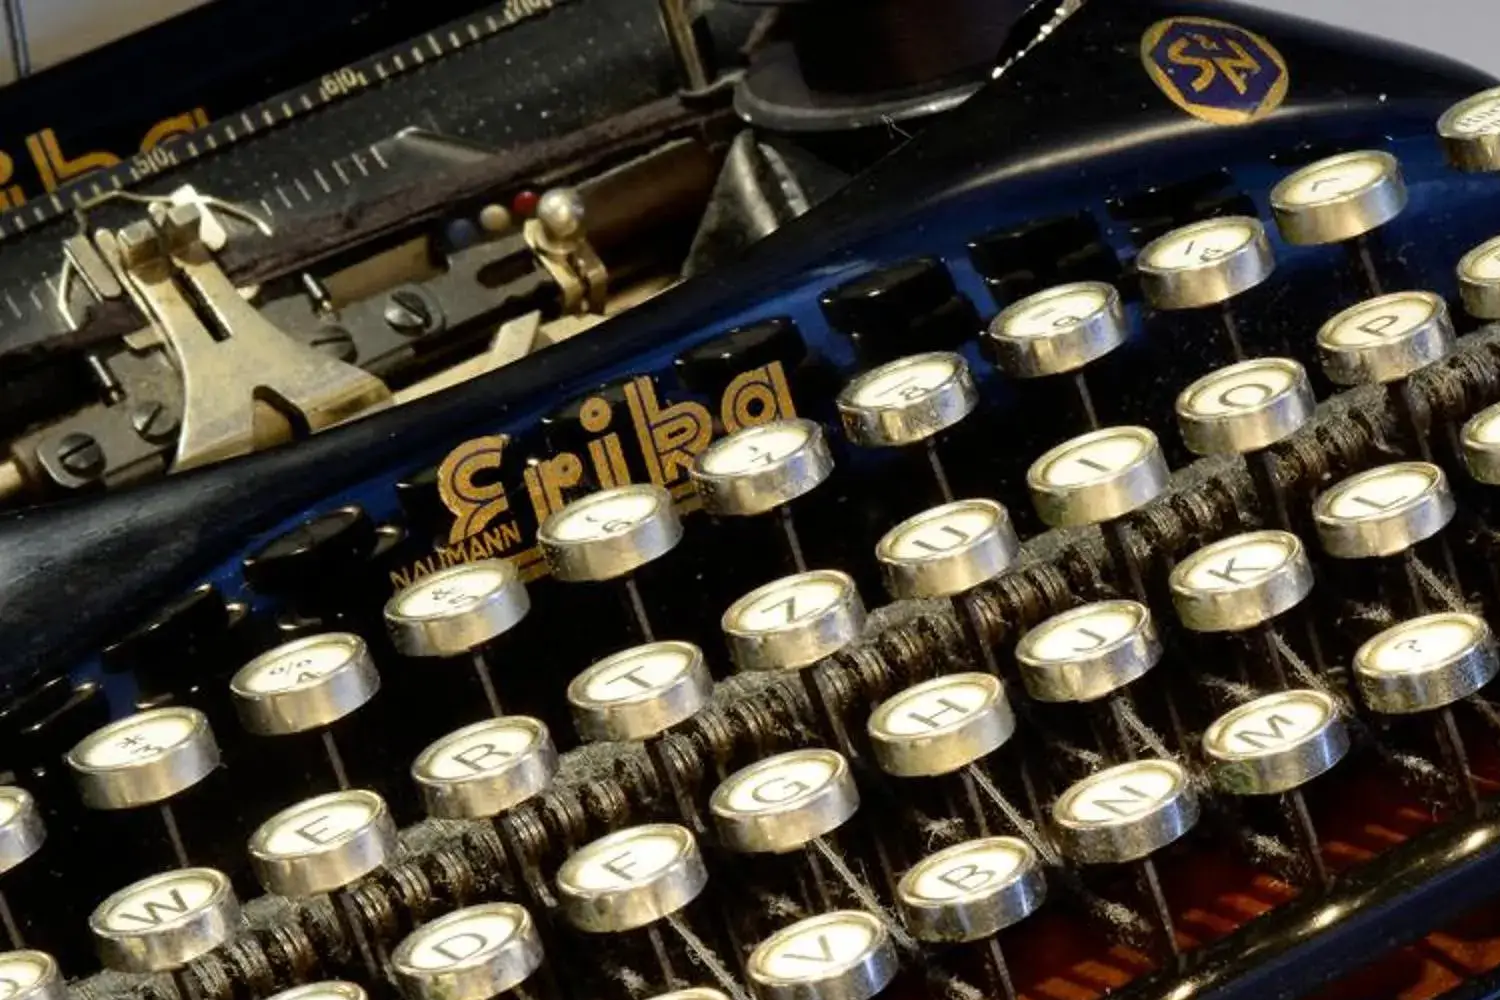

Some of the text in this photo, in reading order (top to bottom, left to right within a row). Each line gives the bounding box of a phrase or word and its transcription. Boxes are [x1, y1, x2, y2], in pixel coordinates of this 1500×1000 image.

[1357, 315, 1400, 338] P
[1218, 383, 1274, 408] O
[1352, 495, 1410, 513] L
[911, 525, 972, 552] U
[1206, 557, 1269, 584] K
[761, 596, 821, 622] Z
[1072, 627, 1108, 653] J
[604, 664, 653, 689] T
[907, 697, 970, 728] H
[1233, 713, 1296, 751] M
[451, 742, 513, 773] R
[751, 777, 811, 803] G
[1091, 784, 1162, 817] N
[294, 814, 354, 846] E
[602, 851, 638, 880] F
[938, 863, 997, 892] B
[119, 888, 190, 924] W
[431, 932, 489, 961] D
[781, 934, 834, 963] V
